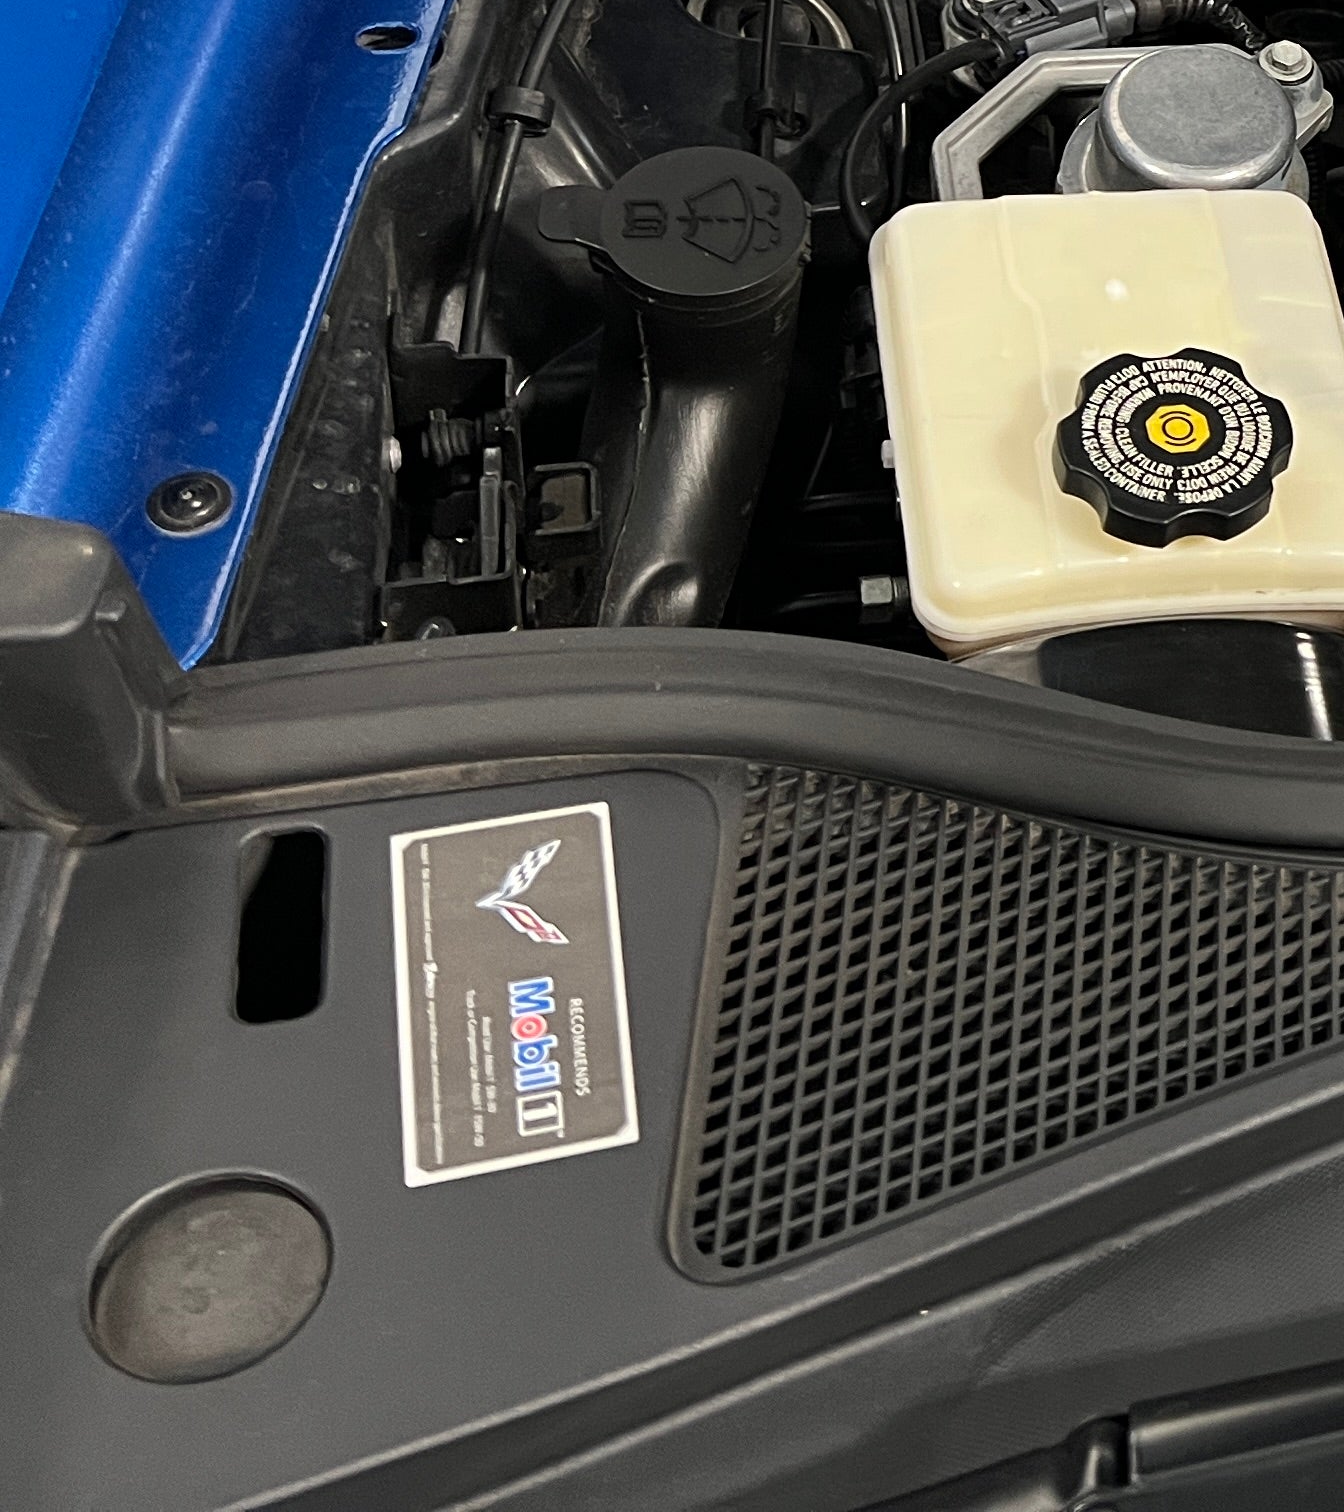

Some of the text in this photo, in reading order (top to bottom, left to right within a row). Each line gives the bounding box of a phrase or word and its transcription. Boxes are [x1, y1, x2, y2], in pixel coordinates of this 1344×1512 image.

[1109, 364, 1140, 385] DOT3
[1128, 375, 1149, 391] CAP
[1208, 366, 1259, 403] NETTOYER
[1156, 382, 1226, 407] PROVENANT
[1218, 385, 1242, 405] QUE
[1082, 430, 1095, 439] A
[1082, 438, 1112, 472] SEALED
[1115, 427, 1139, 458] CLEAN
[1136, 455, 1174, 478] FILLER
[1120, 461, 1145, 481] USE
[1142, 471, 1174, 490] ONLY
[1103, 467, 1166, 503] CONTAINER
[1176, 476, 1209, 491] DOT3
[1220, 479, 1241, 494] LA
[508, 976, 562, 1093] Mobil
[568, 997, 592, 1097] RECOMMENDS
